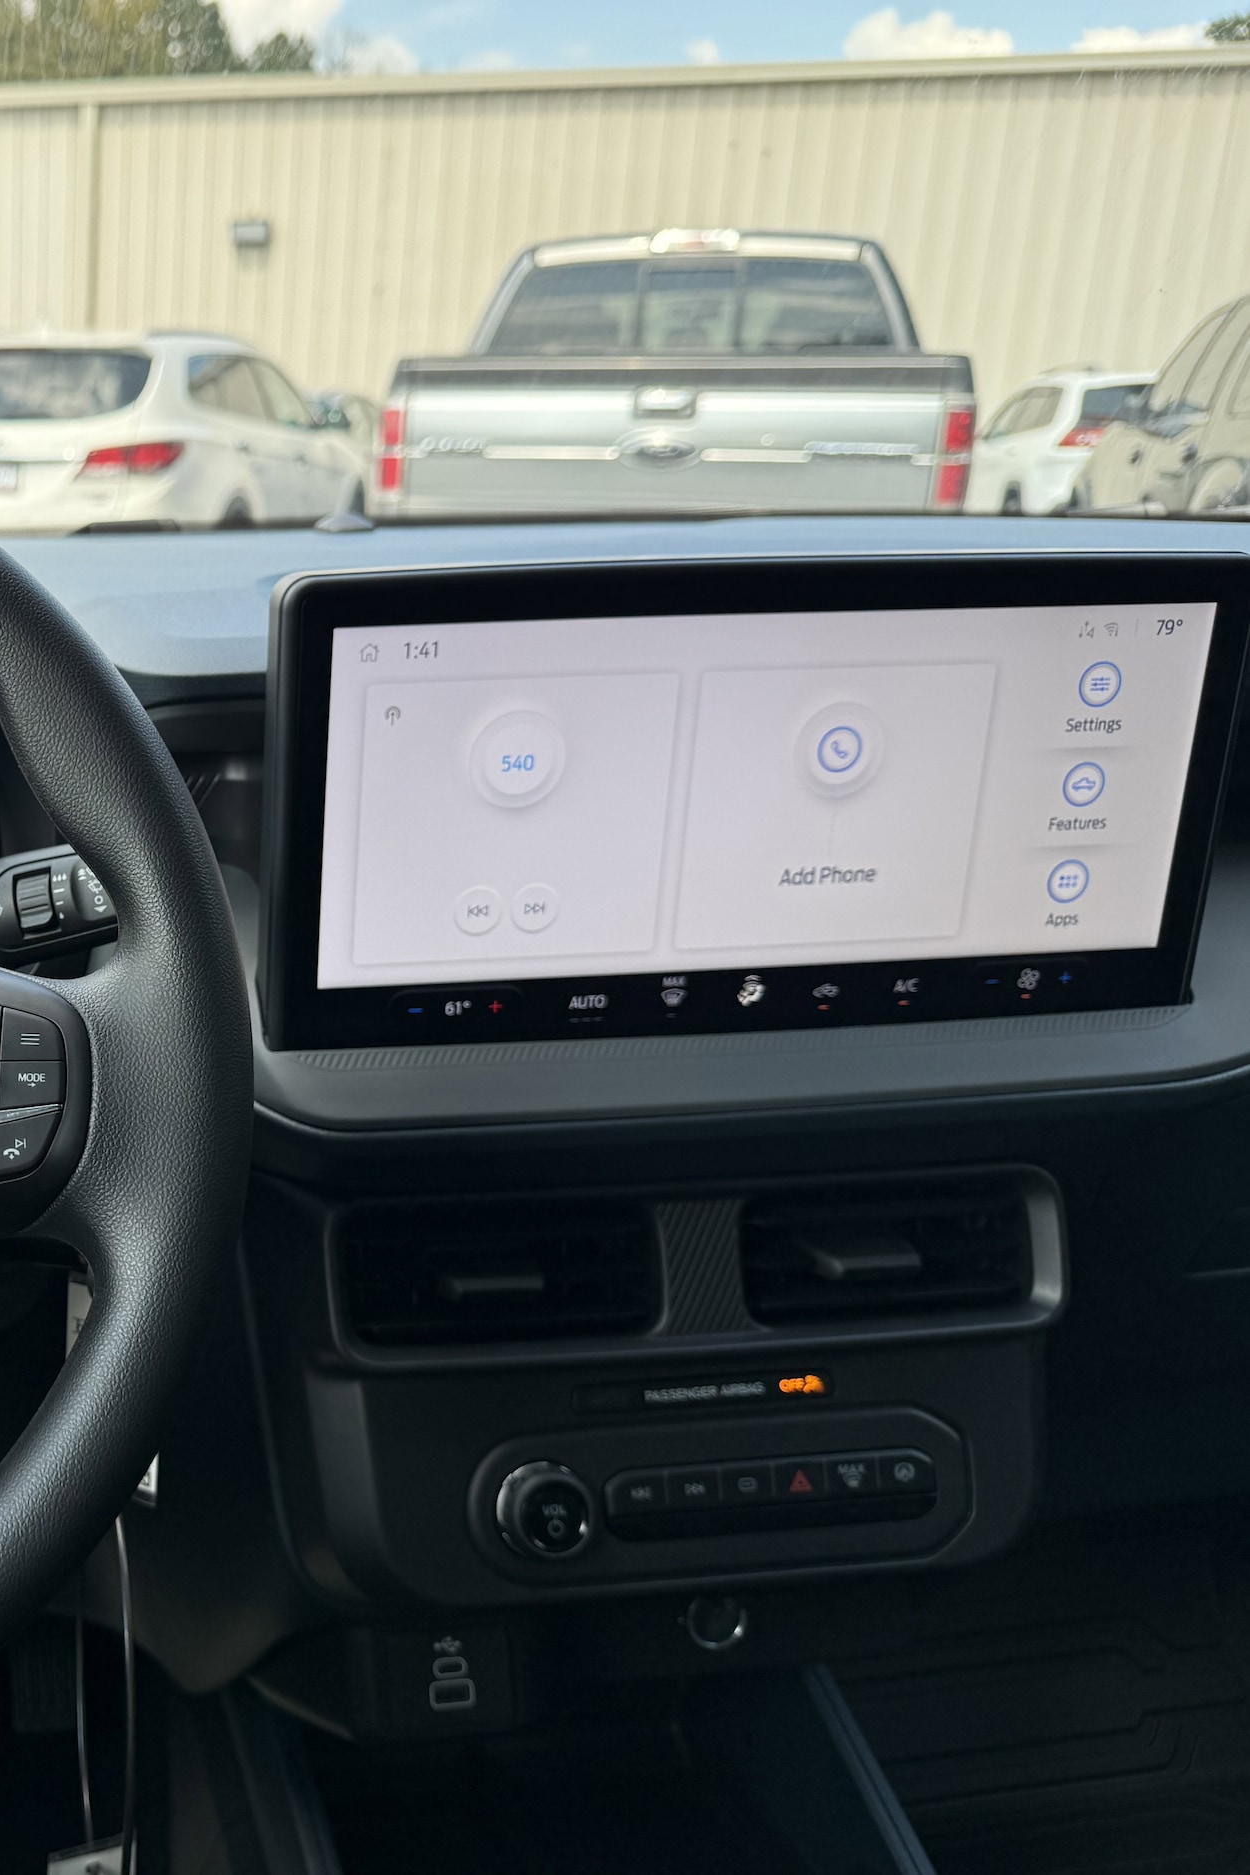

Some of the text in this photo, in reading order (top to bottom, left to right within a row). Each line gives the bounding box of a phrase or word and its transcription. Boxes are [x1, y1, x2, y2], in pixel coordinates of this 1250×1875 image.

[1155, 618, 1184, 637] 79°
[403, 641, 440, 660] 1:41
[1065, 716, 1123, 735] Settings
[500, 754, 535, 773] 540
[1047, 814, 1107, 832] Features
[778, 864, 877, 887] Add Phone
[1044, 912, 1080, 929] Apps
[568, 993, 608, 1011] AUTO
[18, 1072, 46, 1083] MODE
[644, 1385, 719, 1403] PASSENGER
[720, 1380, 766, 1397] AIRBAG
